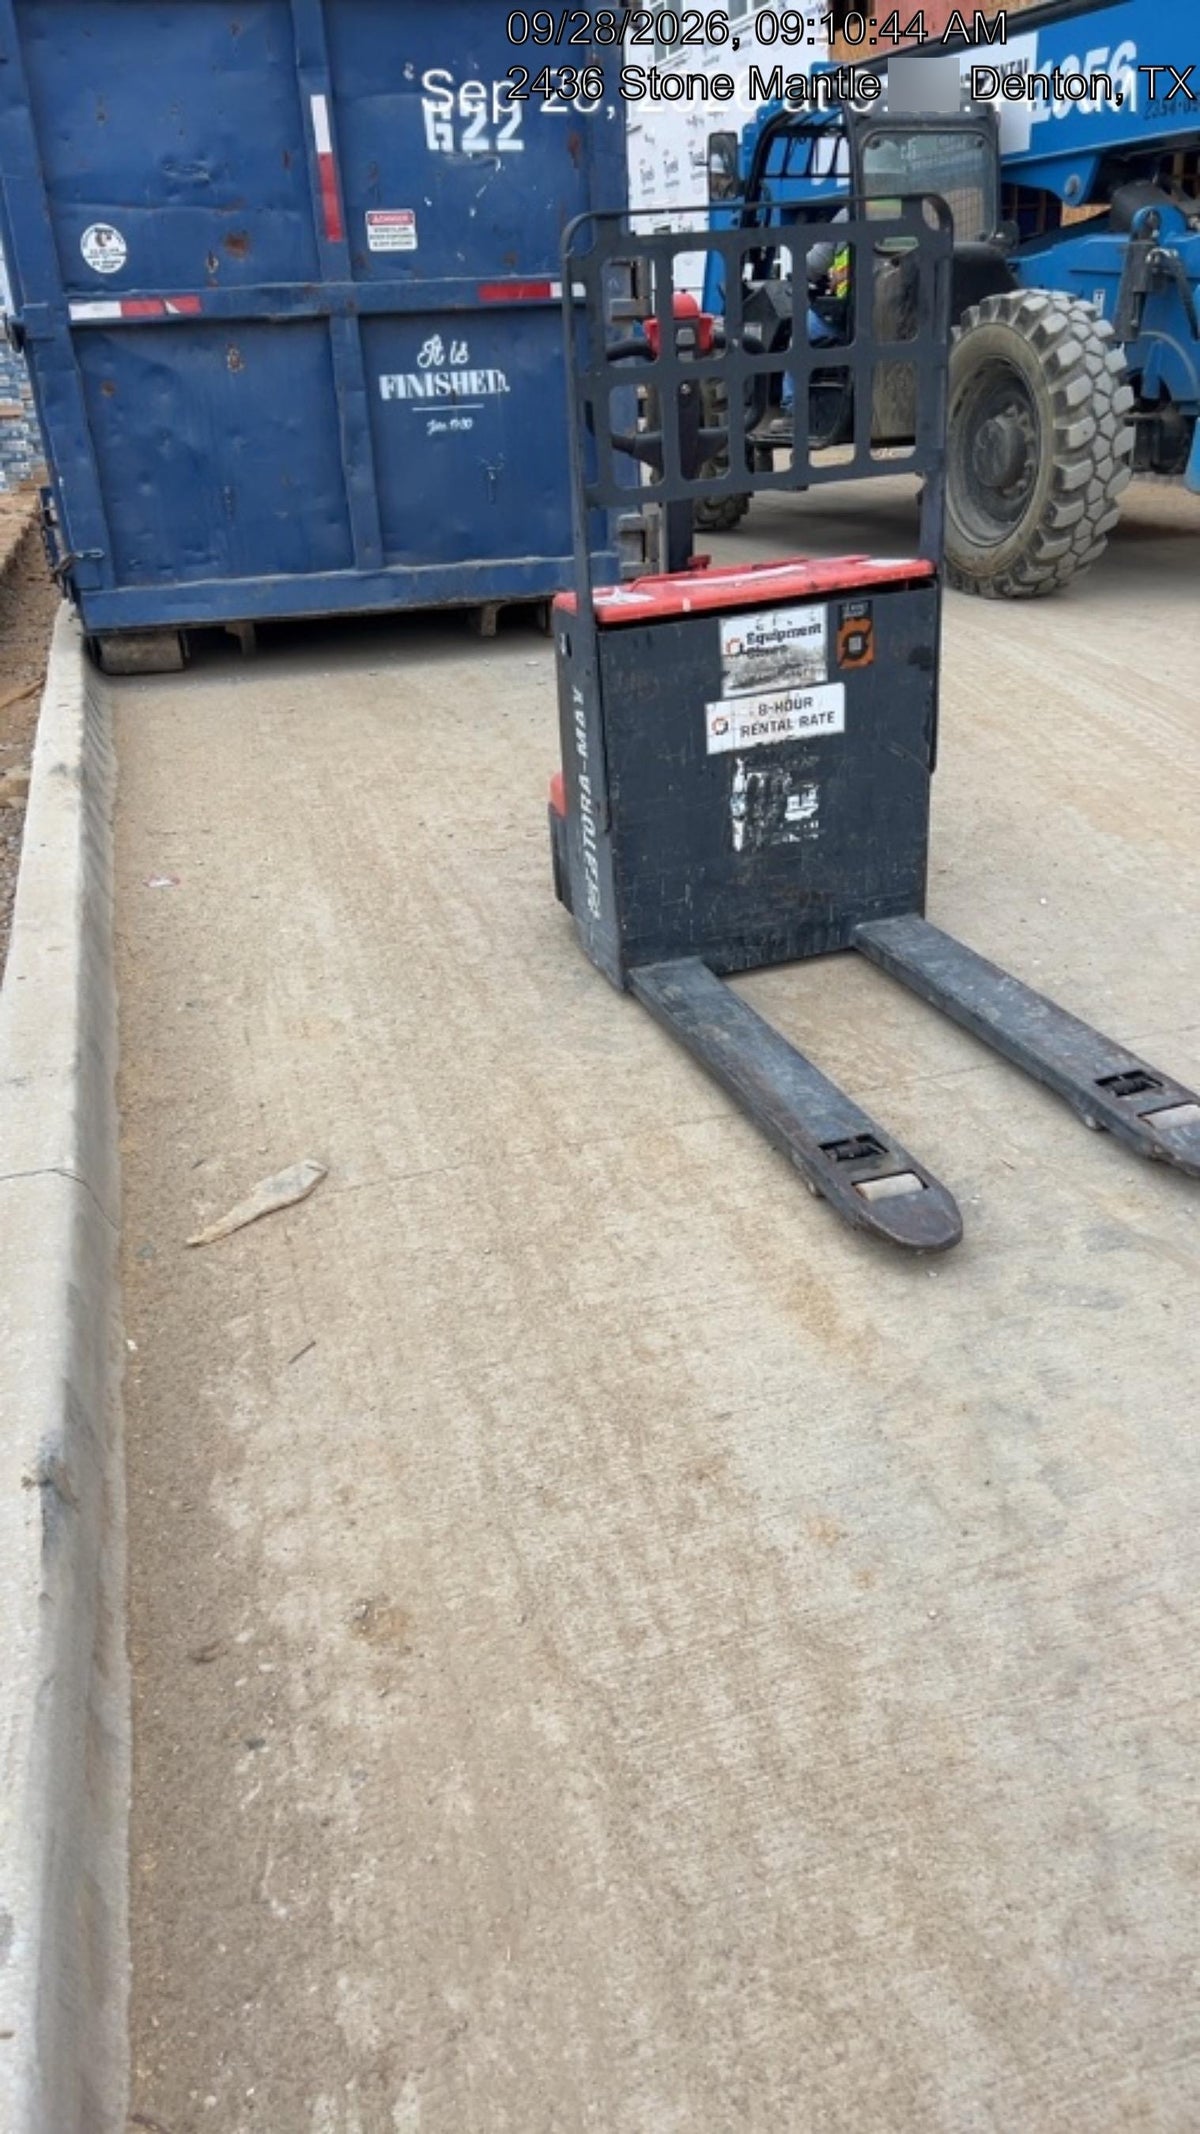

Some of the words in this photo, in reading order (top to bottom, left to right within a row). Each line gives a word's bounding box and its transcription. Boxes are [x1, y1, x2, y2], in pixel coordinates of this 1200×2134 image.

[450, 340, 470, 364] is
[379, 369, 511, 401] FINISHED.
[746, 622, 822, 645] Equipment
[758, 696, 814, 717] 8-HOUR
[740, 718, 794, 738] RENTAL
[799, 711, 836, 727] RATE
